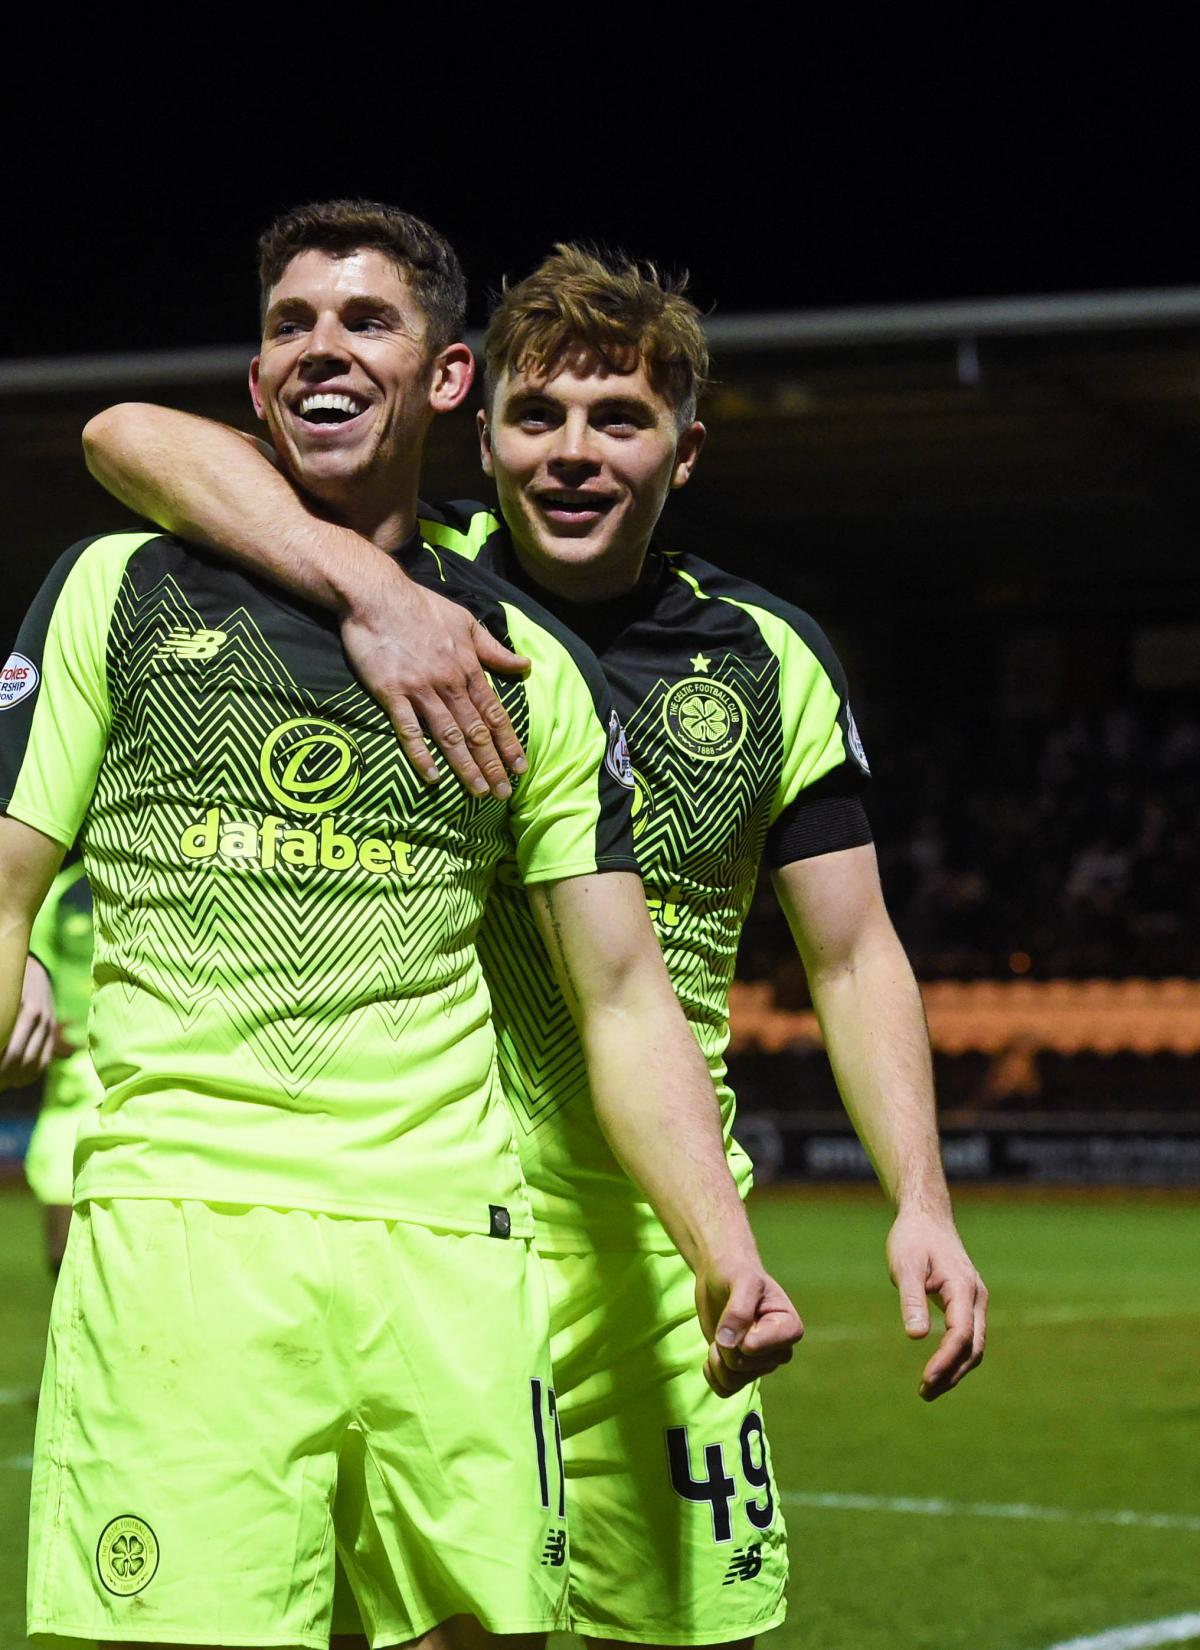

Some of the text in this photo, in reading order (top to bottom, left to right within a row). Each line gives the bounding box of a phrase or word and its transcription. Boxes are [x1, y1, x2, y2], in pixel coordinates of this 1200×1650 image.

[670, 684, 740, 723] THE CELTIC FOOTBALL CLUB
[697, 746, 715, 754] 1888
[179, 807, 416, 875] dafabet
[665, 1409, 777, 1544] 49
